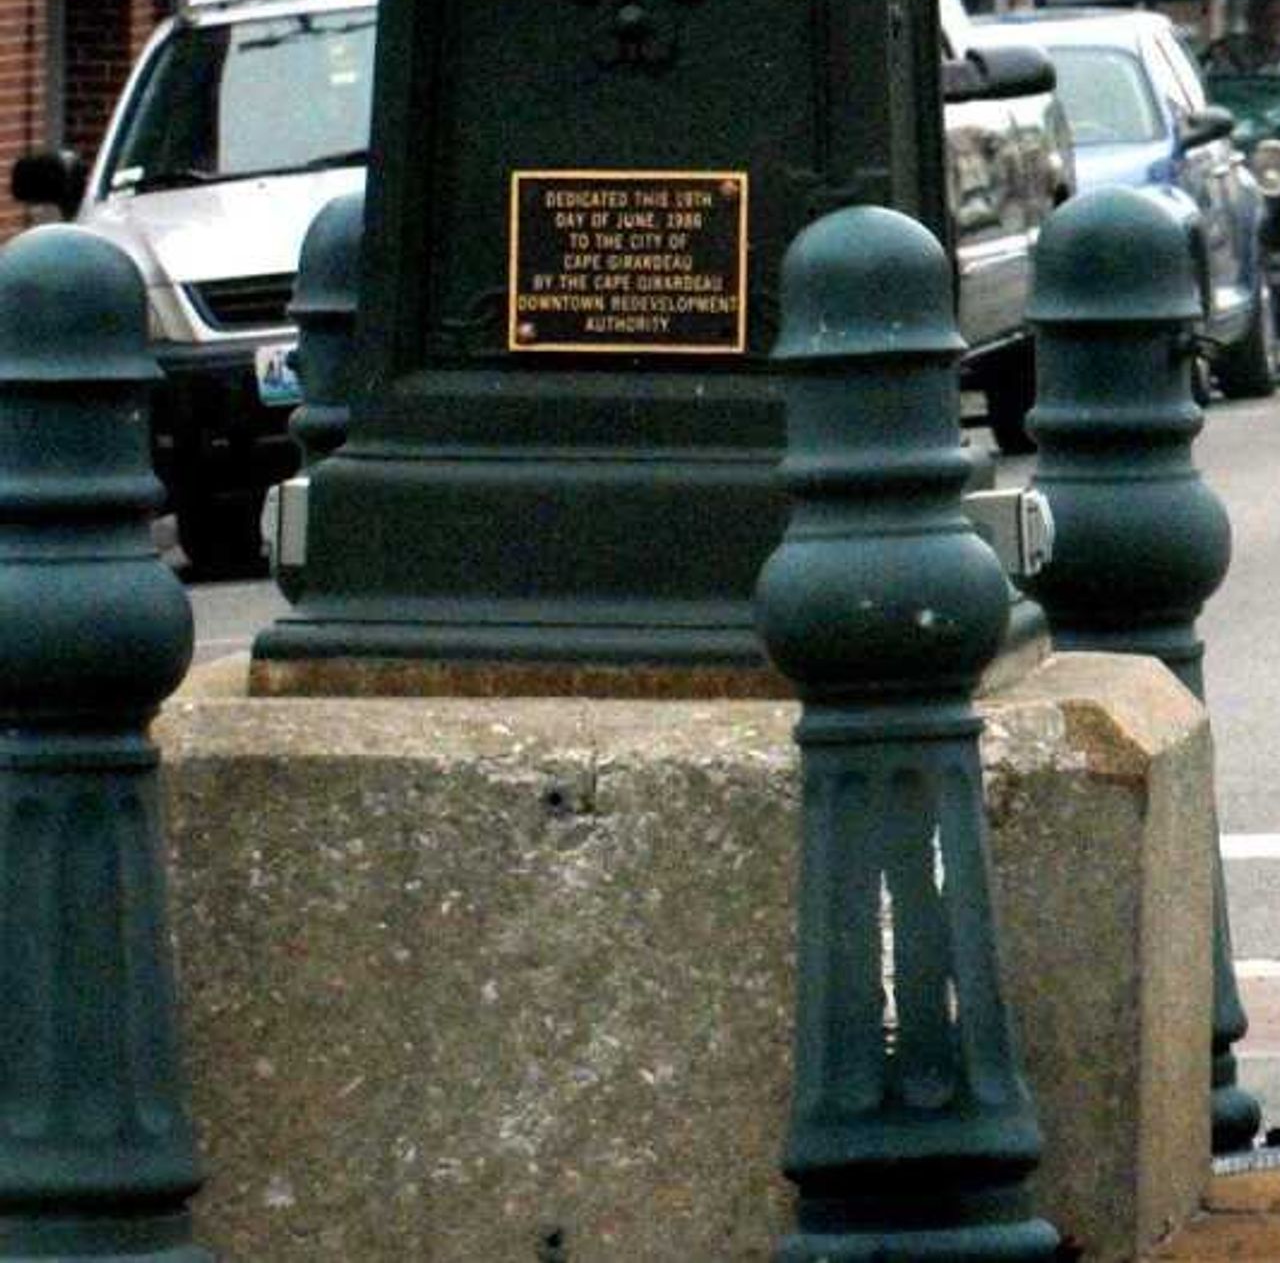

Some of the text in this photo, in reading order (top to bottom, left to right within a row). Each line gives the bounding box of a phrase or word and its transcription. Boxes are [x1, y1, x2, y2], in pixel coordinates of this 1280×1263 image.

[545, 190, 628, 208] DEDICATED
[635, 190, 668, 208] THIS
[556, 212, 583, 228] DAY
[591, 212, 609, 228] OF
[569, 233, 687, 249] TO THE CITY OF
[564, 254, 692, 271] CAPE GIRARDEAU
[533, 273, 723, 291] BY THE CAPE GIRARDEAU
[518, 294, 740, 313] DOWNTOWN REDEVELOPMENT
